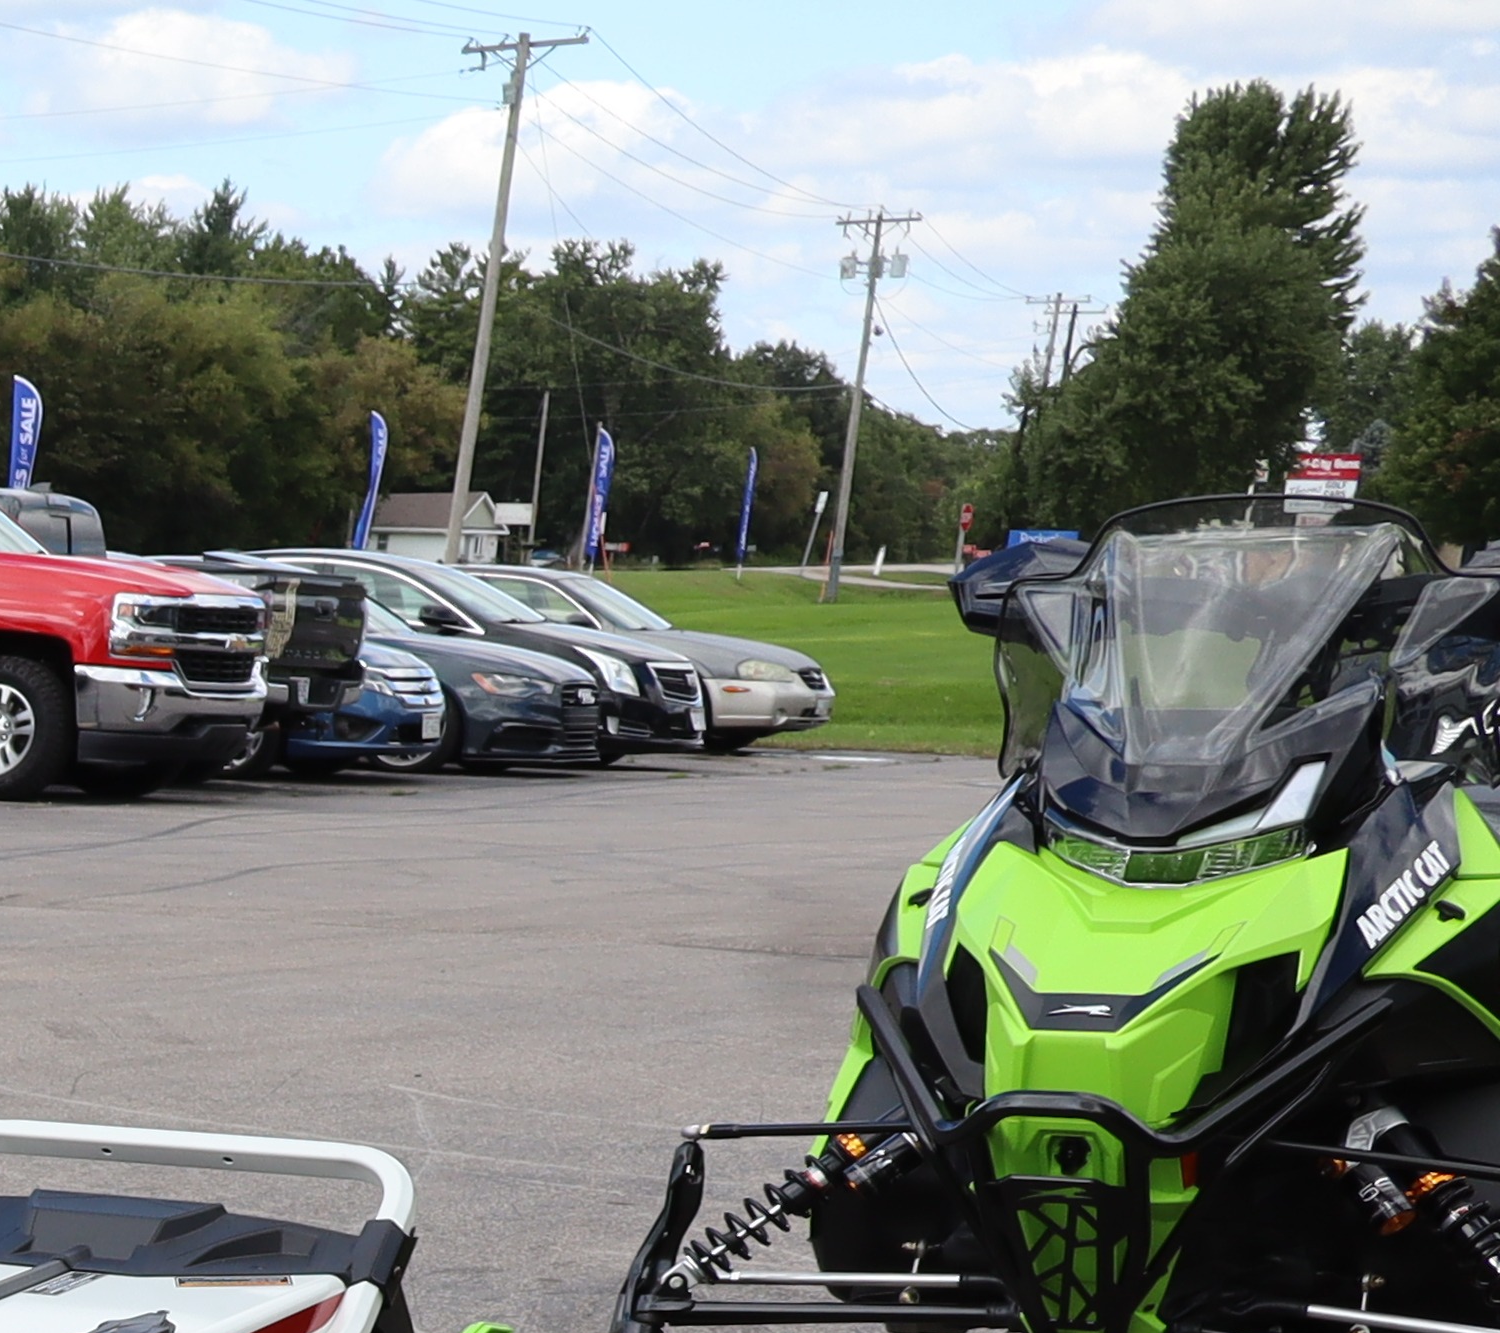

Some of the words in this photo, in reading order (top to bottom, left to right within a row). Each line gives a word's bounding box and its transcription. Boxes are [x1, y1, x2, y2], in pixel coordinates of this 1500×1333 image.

[20, 397, 37, 446] SALE
[1356, 868, 1426, 951] ARCTIC
[1413, 840, 1451, 887] CAT
